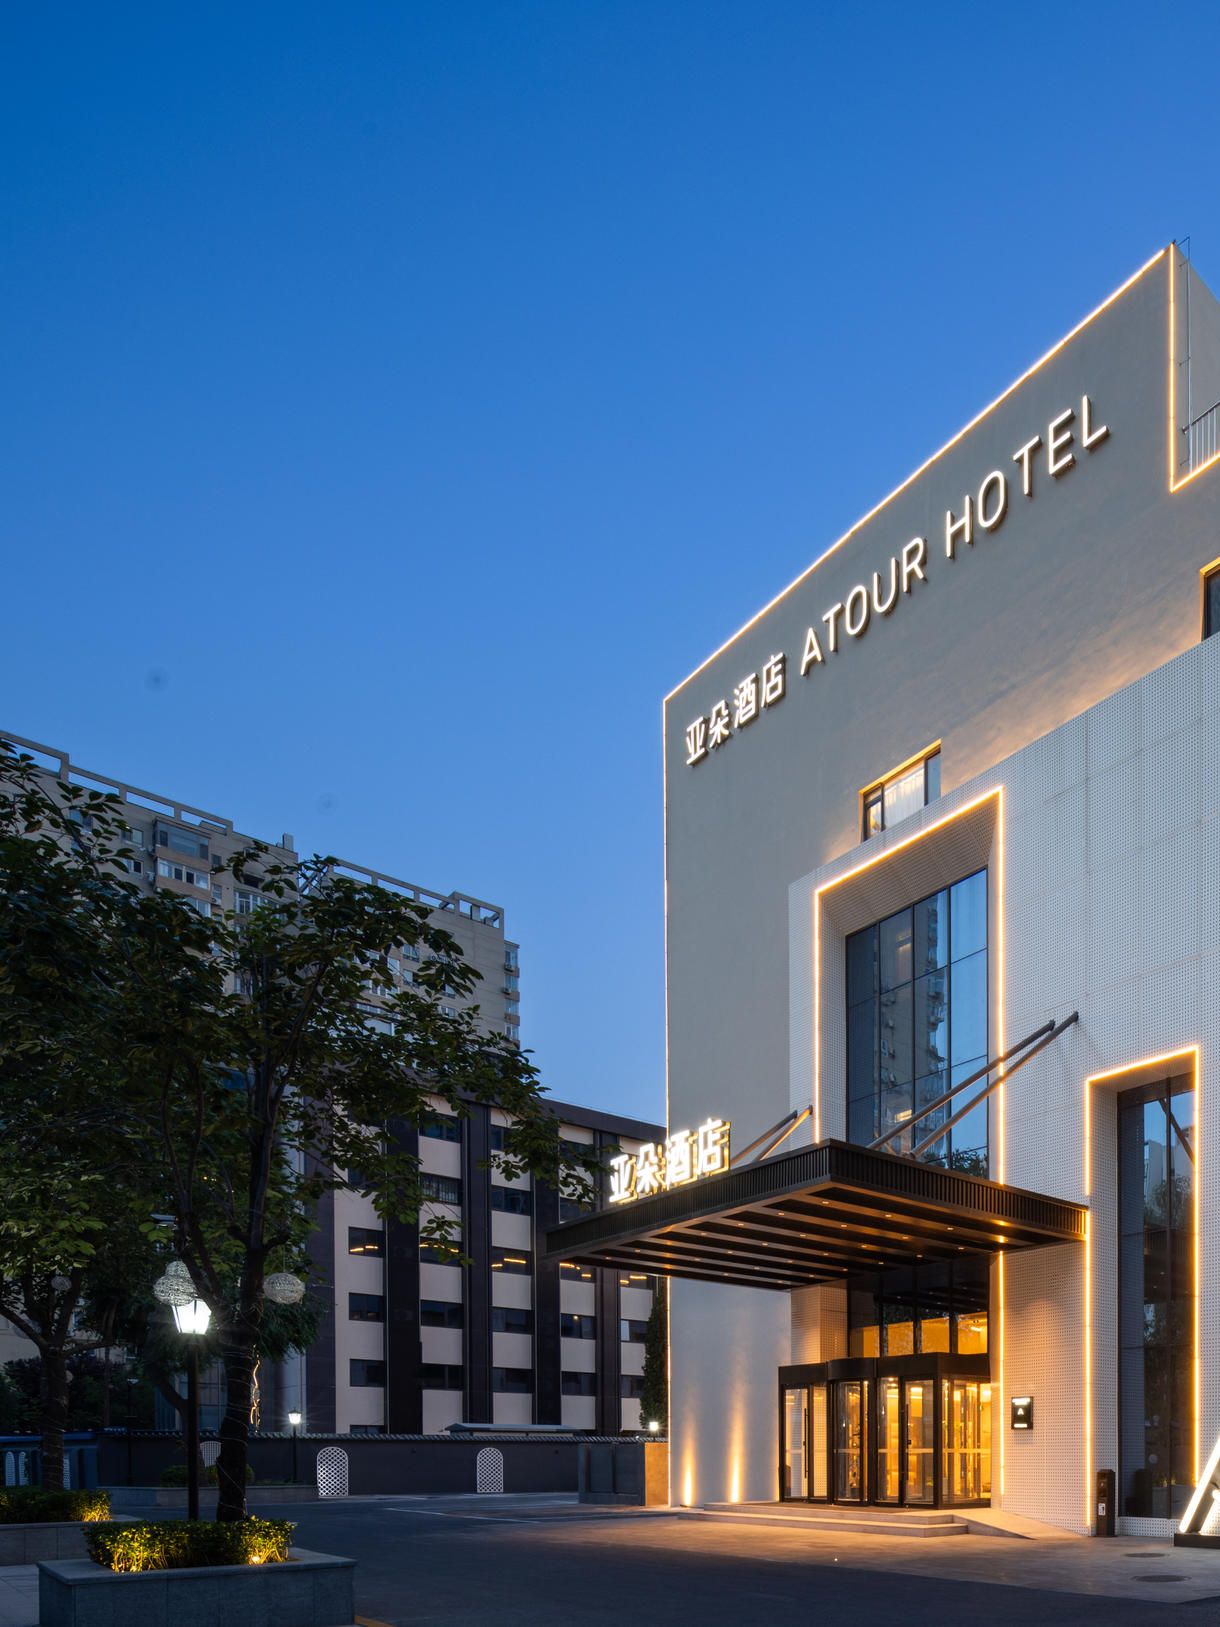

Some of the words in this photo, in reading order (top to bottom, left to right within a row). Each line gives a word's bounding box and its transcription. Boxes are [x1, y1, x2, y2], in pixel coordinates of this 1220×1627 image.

[686, 652, 785, 765] 亚朵酒店
[800, 537, 926, 676] ATOUR
[945, 395, 1108, 558] HOTEL
[609, 1117, 731, 1203] 亚朵酒店
